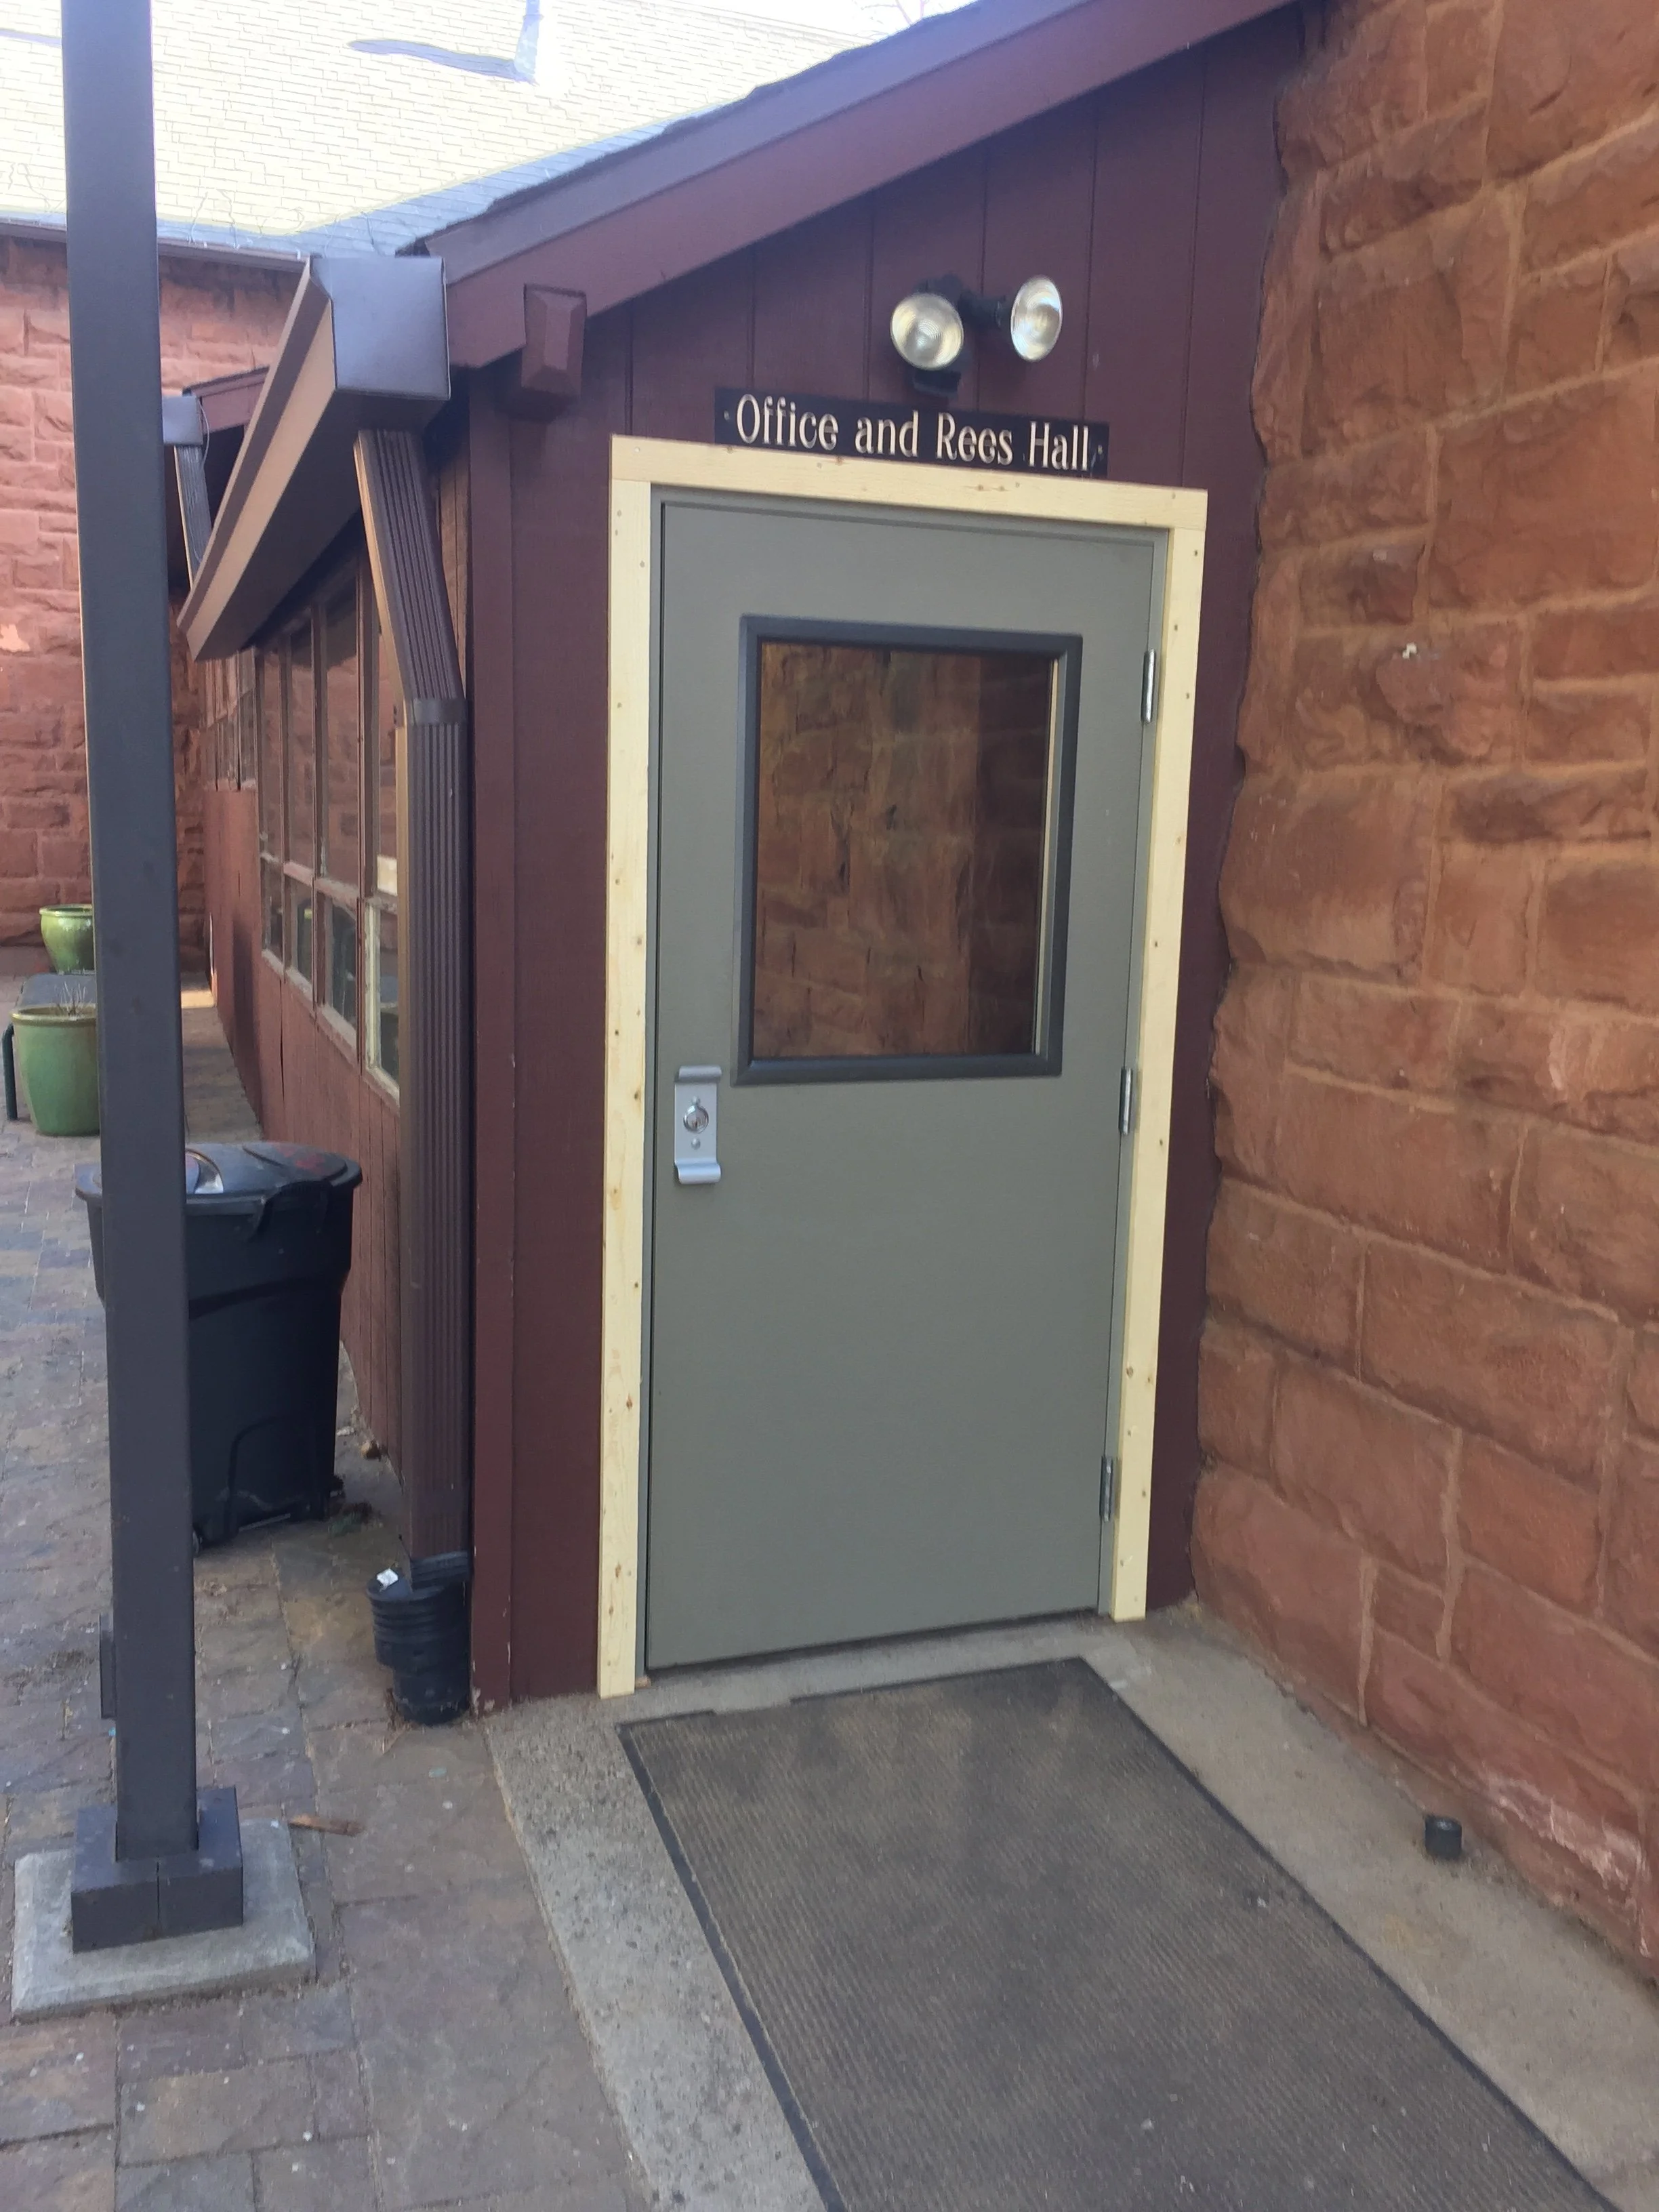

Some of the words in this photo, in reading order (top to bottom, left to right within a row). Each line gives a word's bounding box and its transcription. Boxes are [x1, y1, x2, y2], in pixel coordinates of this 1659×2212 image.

[737, 394, 838, 450] Office
[855, 410, 919, 457] and
[935, 412, 1013, 466] Rees
[1028, 421, 1088, 471] Hall
